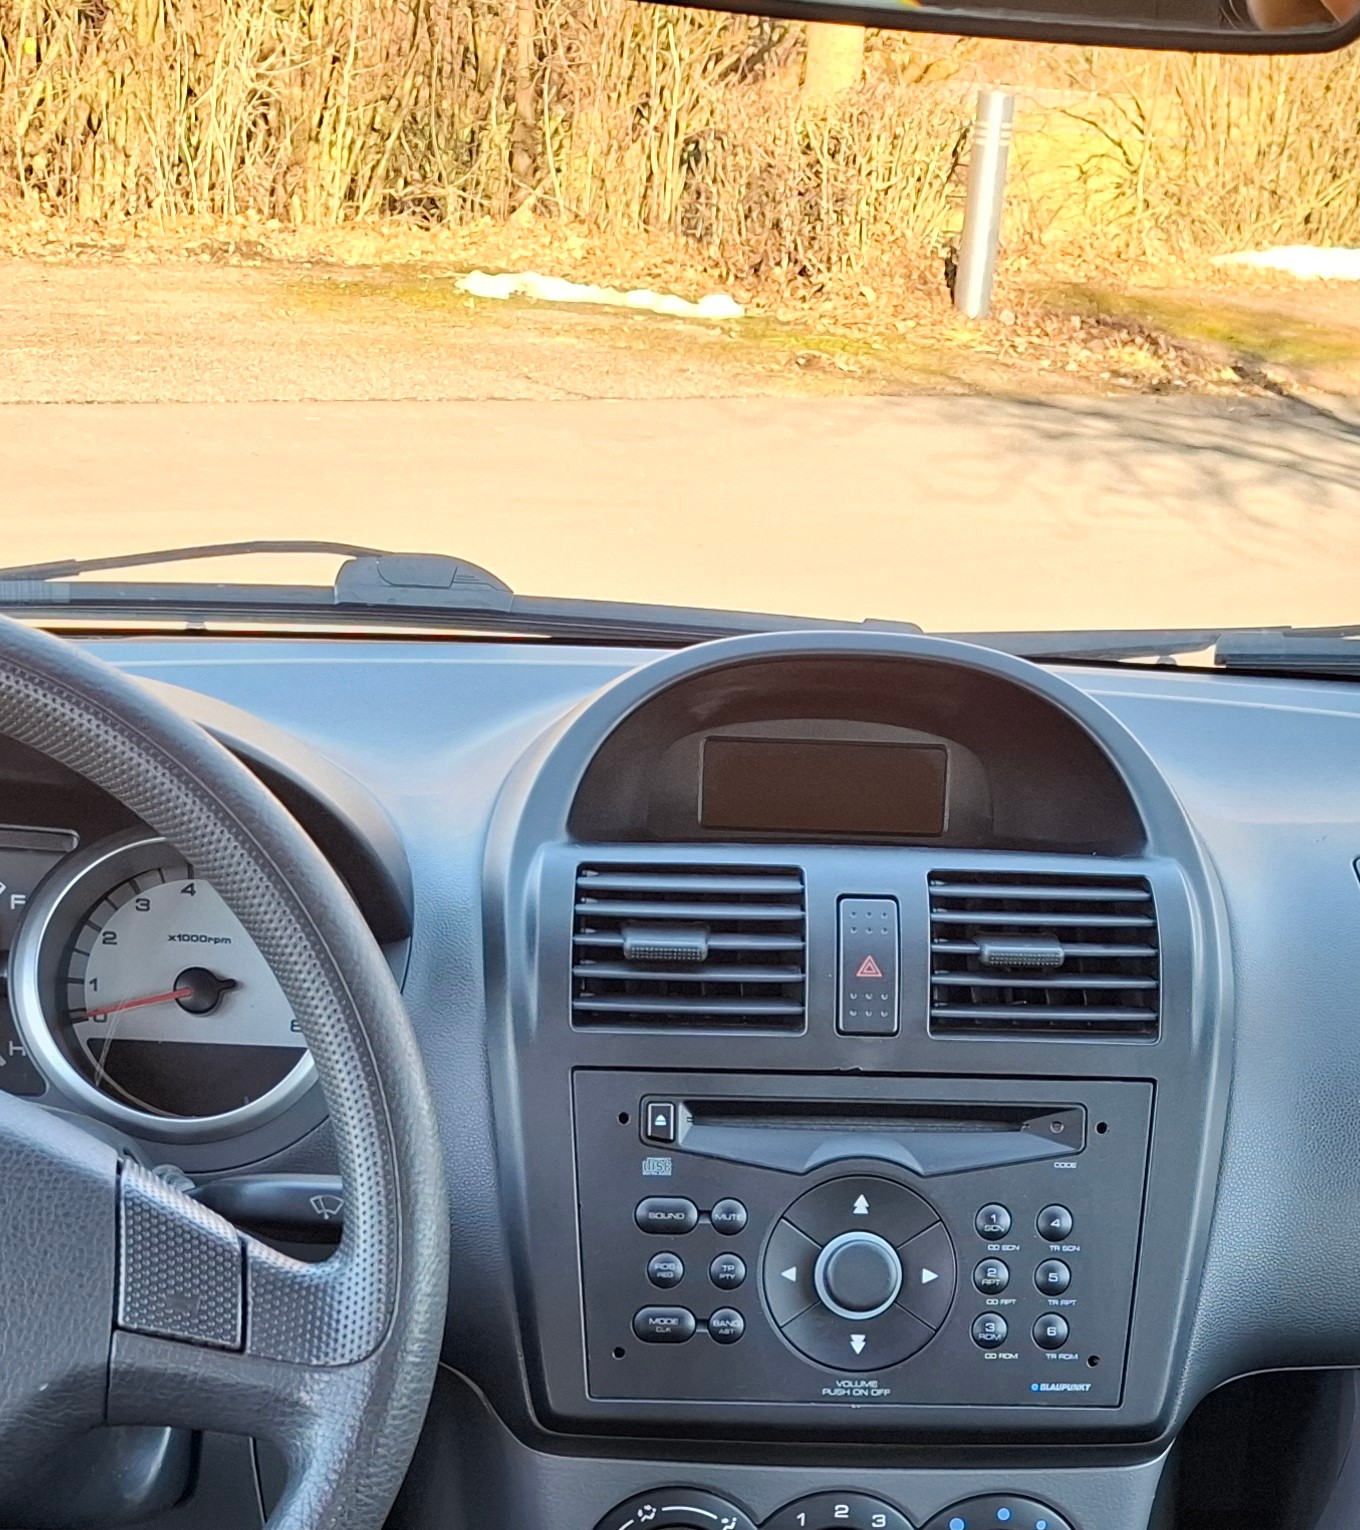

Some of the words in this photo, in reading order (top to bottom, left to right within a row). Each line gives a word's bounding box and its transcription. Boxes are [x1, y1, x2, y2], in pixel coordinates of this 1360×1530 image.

[180, 882, 197, 896] 4
[10, 894, 26, 910] F
[135, 897, 151, 912] 3
[101, 930, 118, 945] 2
[167, 933, 232, 945] x1000rpm
[89, 978, 99, 992] 1
[9, 1040, 26, 1057] H
[648, 1212, 685, 1220] SOUND
[714, 1213, 744, 1221] MUTE
[990, 1214, 996, 1223] 1
[983, 1224, 1005, 1232] SCN
[1050, 1219, 1061, 1228] 4
[721, 1264, 735, 1272] TP
[986, 1268, 997, 1277] 2
[1048, 1273, 1058, 1282] 5
[648, 1317, 679, 1325] MODE
[712, 1319, 740, 1327] BAND
[985, 1322, 995, 1332] 3
[1046, 1326, 1057, 1336] 6
[835, 1380, 878, 1388] VOLUME
[1039, 1383, 1092, 1391] BLAUPUNKT
[822, 1388, 851, 1396] PUSH
[852, 1388, 869, 1396] ON
[834, 1504, 850, 1519] 2
[796, 1512, 806, 1527] 1
[871, 1514, 886, 1528] 3
